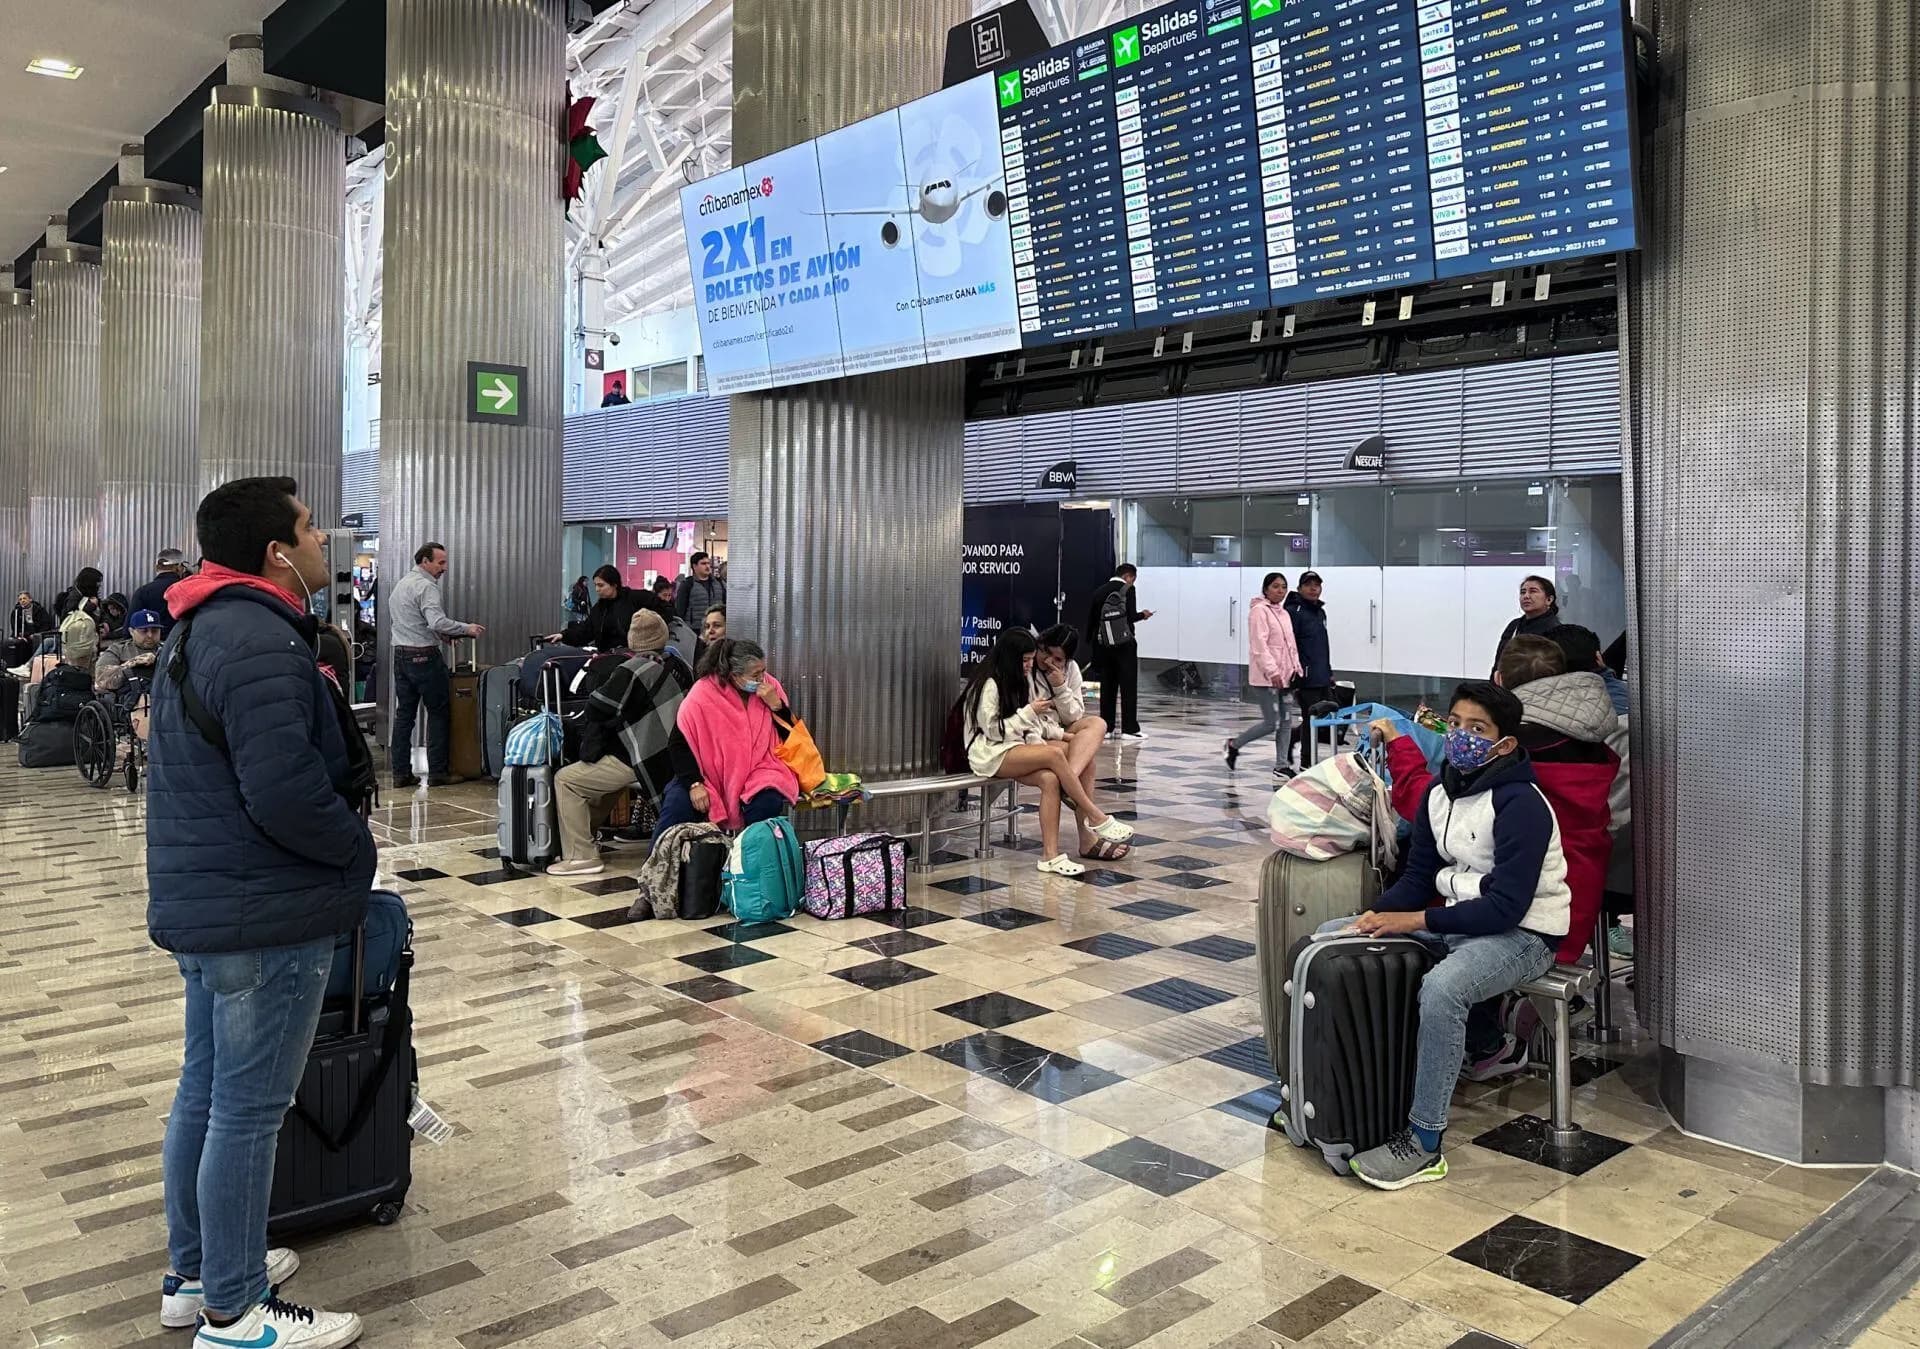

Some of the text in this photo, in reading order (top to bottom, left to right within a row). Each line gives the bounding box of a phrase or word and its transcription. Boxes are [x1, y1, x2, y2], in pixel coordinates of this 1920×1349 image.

[1142, 8, 1198, 40] Salidas
[1483, 24, 1518, 39] P.VALLARTA
[1574, 0, 1604, 12] DELAYED
[1423, 28, 1443, 38] UNITED
[1485, 45, 1521, 59] S.SALVADOR
[1575, 21, 1604, 34] ARRIVED
[1143, 30, 1198, 57] Departures
[1576, 41, 1605, 53] ARRIVED
[1022, 56, 1070, 84] Salidas
[1024, 76, 1070, 98] Departures
[1487, 82, 1524, 96] HERMOSILLO
[1489, 107, 1511, 117] DALLAS
[1491, 138, 1527, 151] MONTERREY
[1493, 160, 1528, 171] P.VALLARTA
[699, 184, 763, 216] citibanamex
[1588, 218, 1618, 228] DELAYED
[701, 216, 792, 279] 2X1 EN
[1527, 247, 1560, 257] diciembre
[1565, 243, 1581, 251] 2023
[1587, 239, 1606, 248] 11:19
[706, 242, 860, 303] BOLETOS DE AVIÓN
[708, 276, 850, 323] DE BIENVENIDA Y CADA AÑO
[896, 281, 996, 312] Con Citibanamex GANA MÁS
[1356, 453, 1384, 468] NESCAFÉ
[1050, 472, 1075, 482] BBVA
[1000, 544, 1024, 557] PARA
[980, 562, 1020, 574] SERVICIO
[972, 616, 1002, 630] Pasillo
[992, 635, 997, 647] 1
